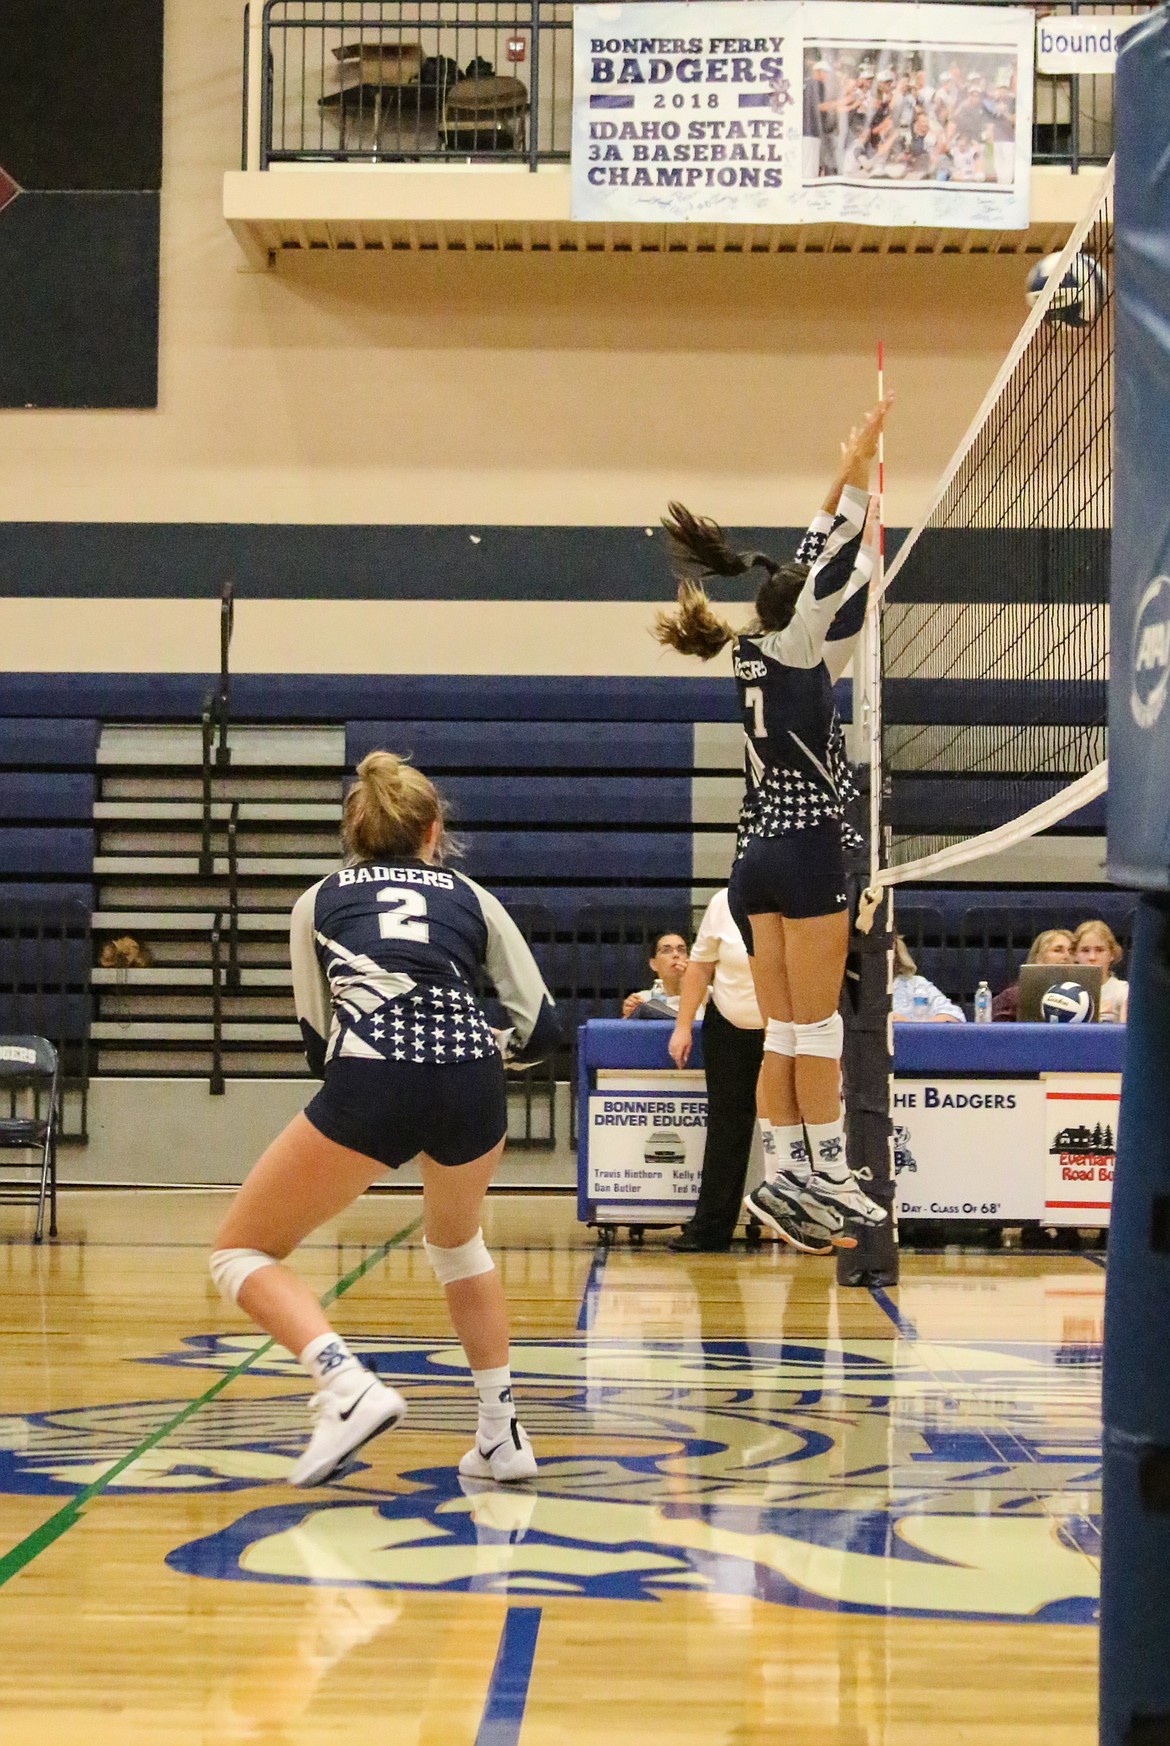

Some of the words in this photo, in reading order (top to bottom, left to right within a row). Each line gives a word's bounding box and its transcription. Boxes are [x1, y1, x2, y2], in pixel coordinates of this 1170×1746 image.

[590, 38, 703, 54] BONNERS
[709, 37, 785, 53] FERRY
[591, 57, 784, 84] BADGERS
[653, 93, 719, 108] 2018
[588, 120, 681, 140] IDAHO
[687, 119, 783, 140] STATE
[588, 144, 623, 162] 3A
[632, 143, 782, 162] BASEBALL
[587, 166, 783, 188] CHAMPIONS
[338, 866, 454, 890] BADGERS
[376, 887, 430, 944] 2
[603, 1101, 676, 1114] BONNERS
[594, 1114, 648, 1126] DRIVER
[594, 1168, 621, 1179] Travis
[624, 1169, 662, 1179] Hinthorn
[672, 1170, 694, 1181] Kelly
[1062, 1167, 1094, 1181] Road
[595, 1183, 610, 1192] Dan
[672, 1184, 688, 1193] Ted
